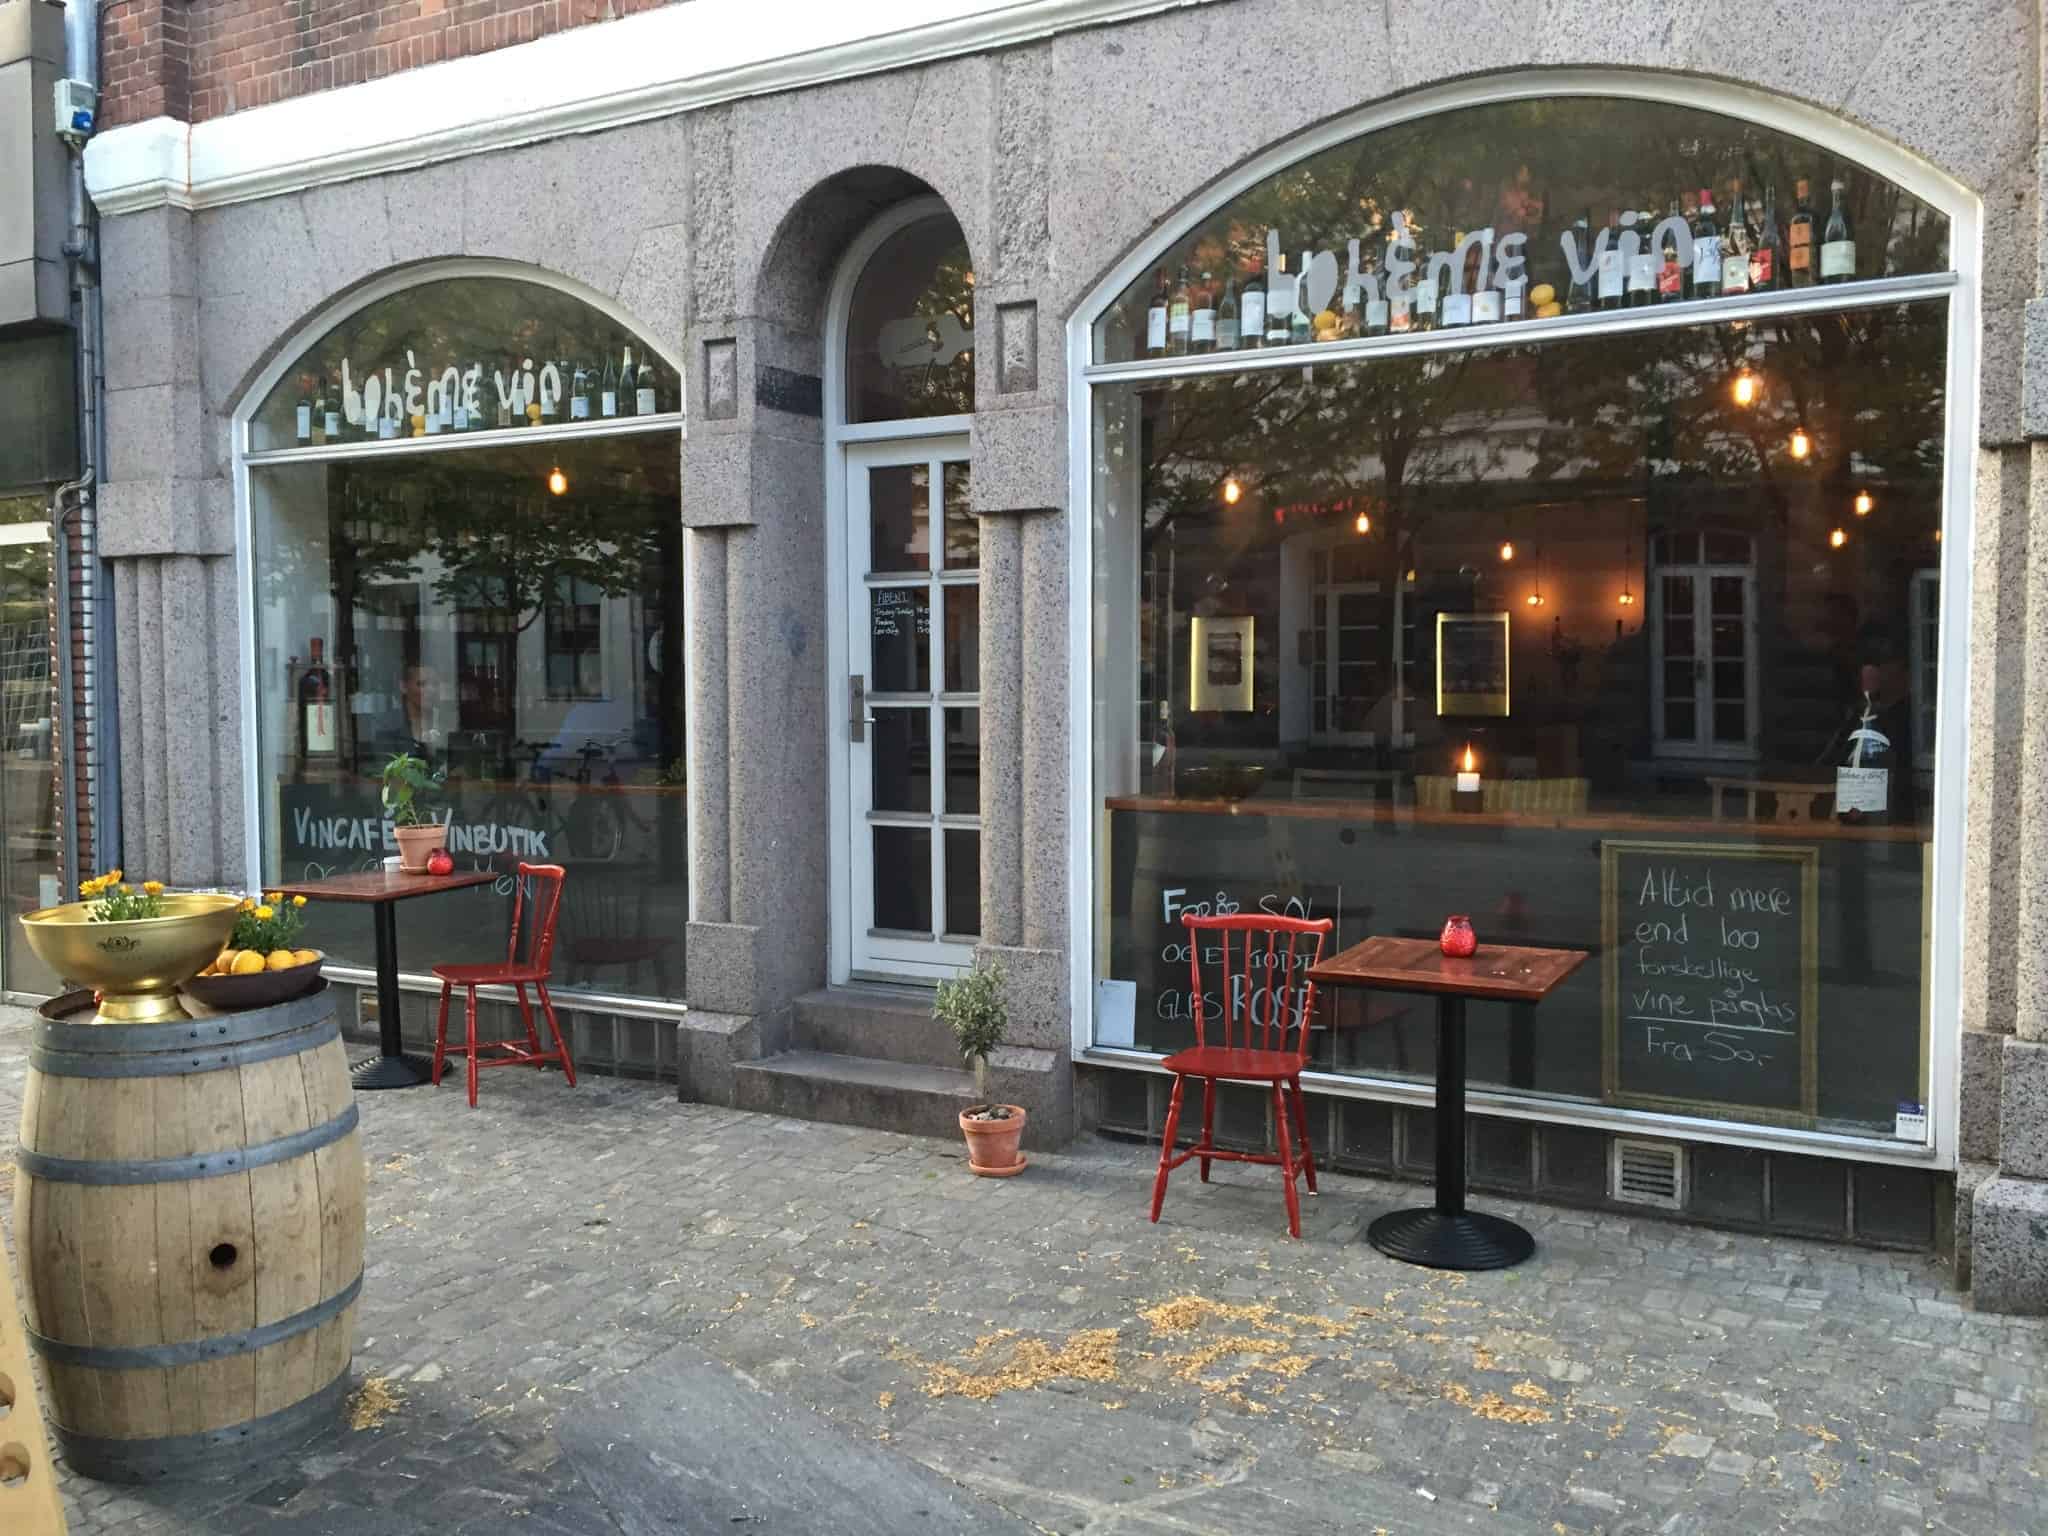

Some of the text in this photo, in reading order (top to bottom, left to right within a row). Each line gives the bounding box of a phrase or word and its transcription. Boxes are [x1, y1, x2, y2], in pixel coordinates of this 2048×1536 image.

[1560, 210, 1695, 285] vin
[494, 358, 562, 411] vin
[1639, 866, 1793, 916] Altid mere
[1635, 912, 1689, 945] end
[1632, 989, 1695, 1015] vine
[1647, 1025, 1693, 1063] Fra
